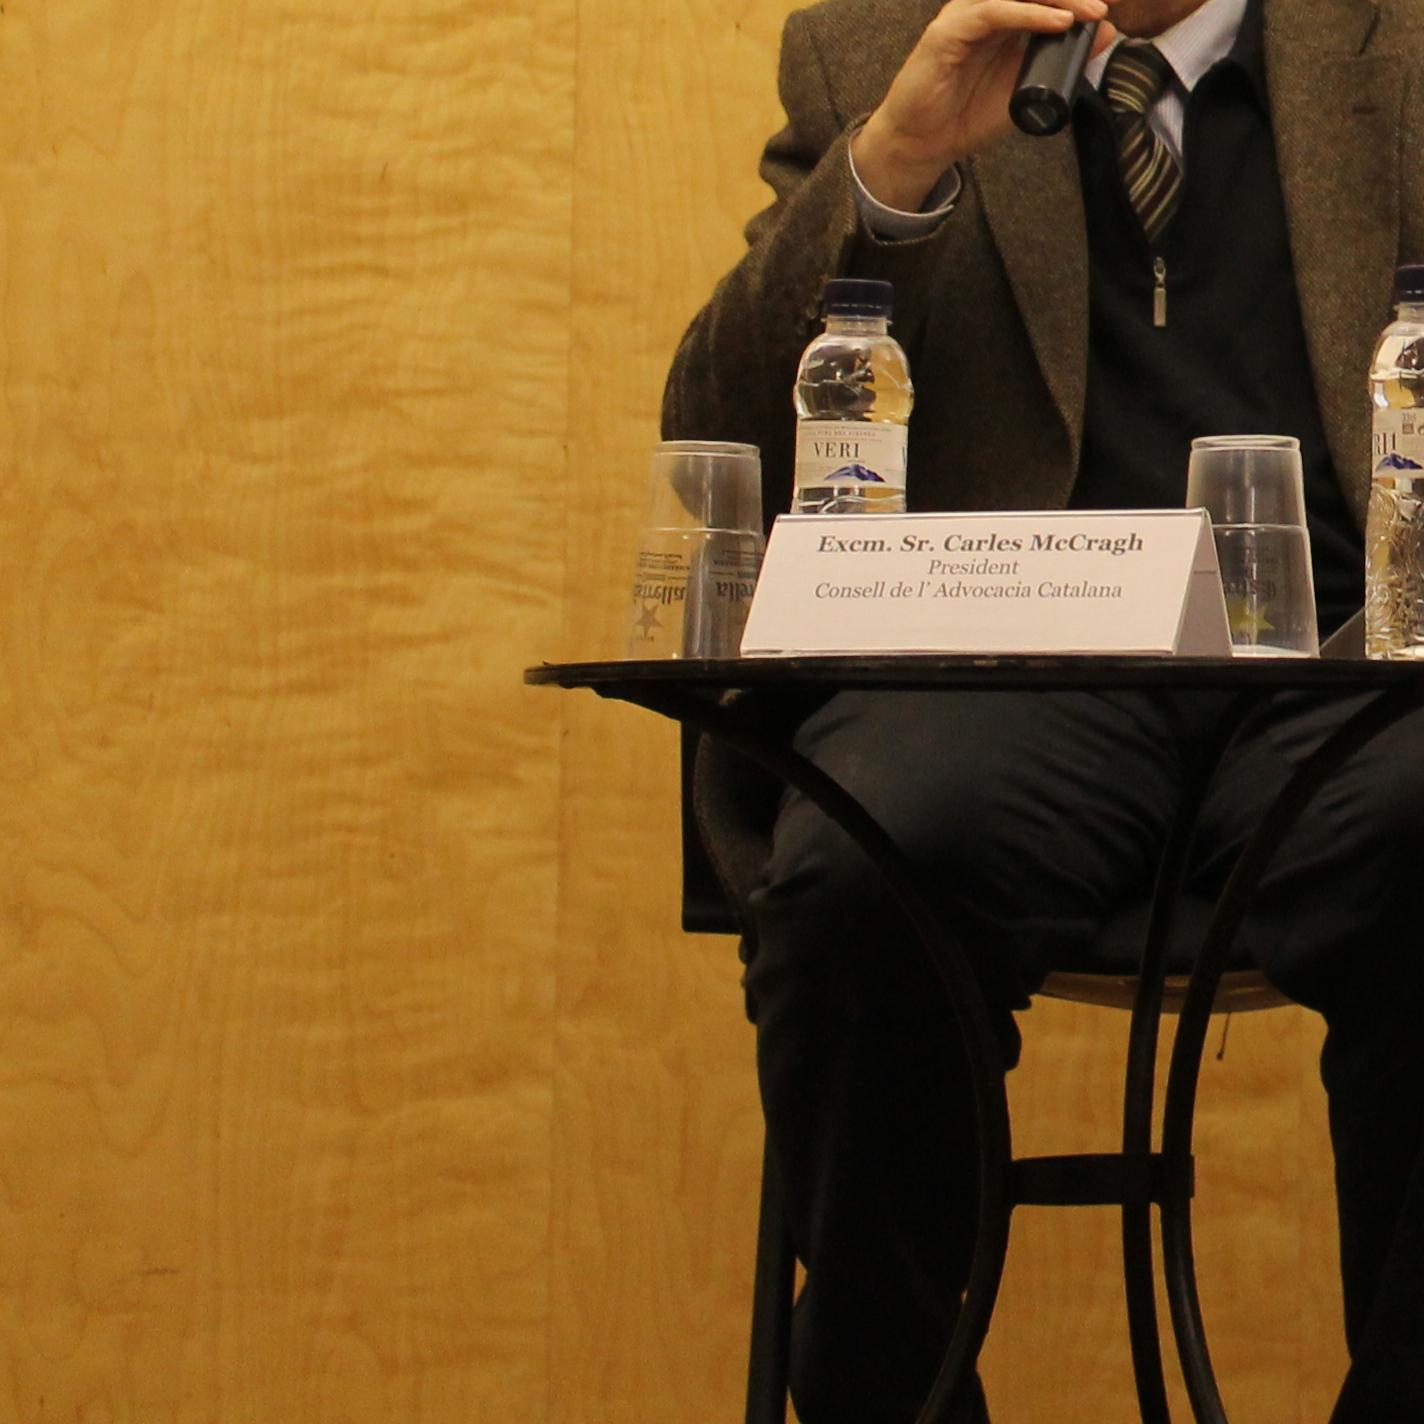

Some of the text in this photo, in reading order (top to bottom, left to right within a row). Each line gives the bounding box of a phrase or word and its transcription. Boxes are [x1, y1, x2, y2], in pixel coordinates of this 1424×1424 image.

[814, 441, 860, 458] VERI
[817, 532, 1144, 556] Excm. Sr. Carles McCragh
[928, 558, 1019, 576] President
[814, 581, 885, 599] Consell
[889, 581, 913, 599] de
[933, 580, 1032, 599] Advocacia
[1037, 580, 1122, 599] Catalana
